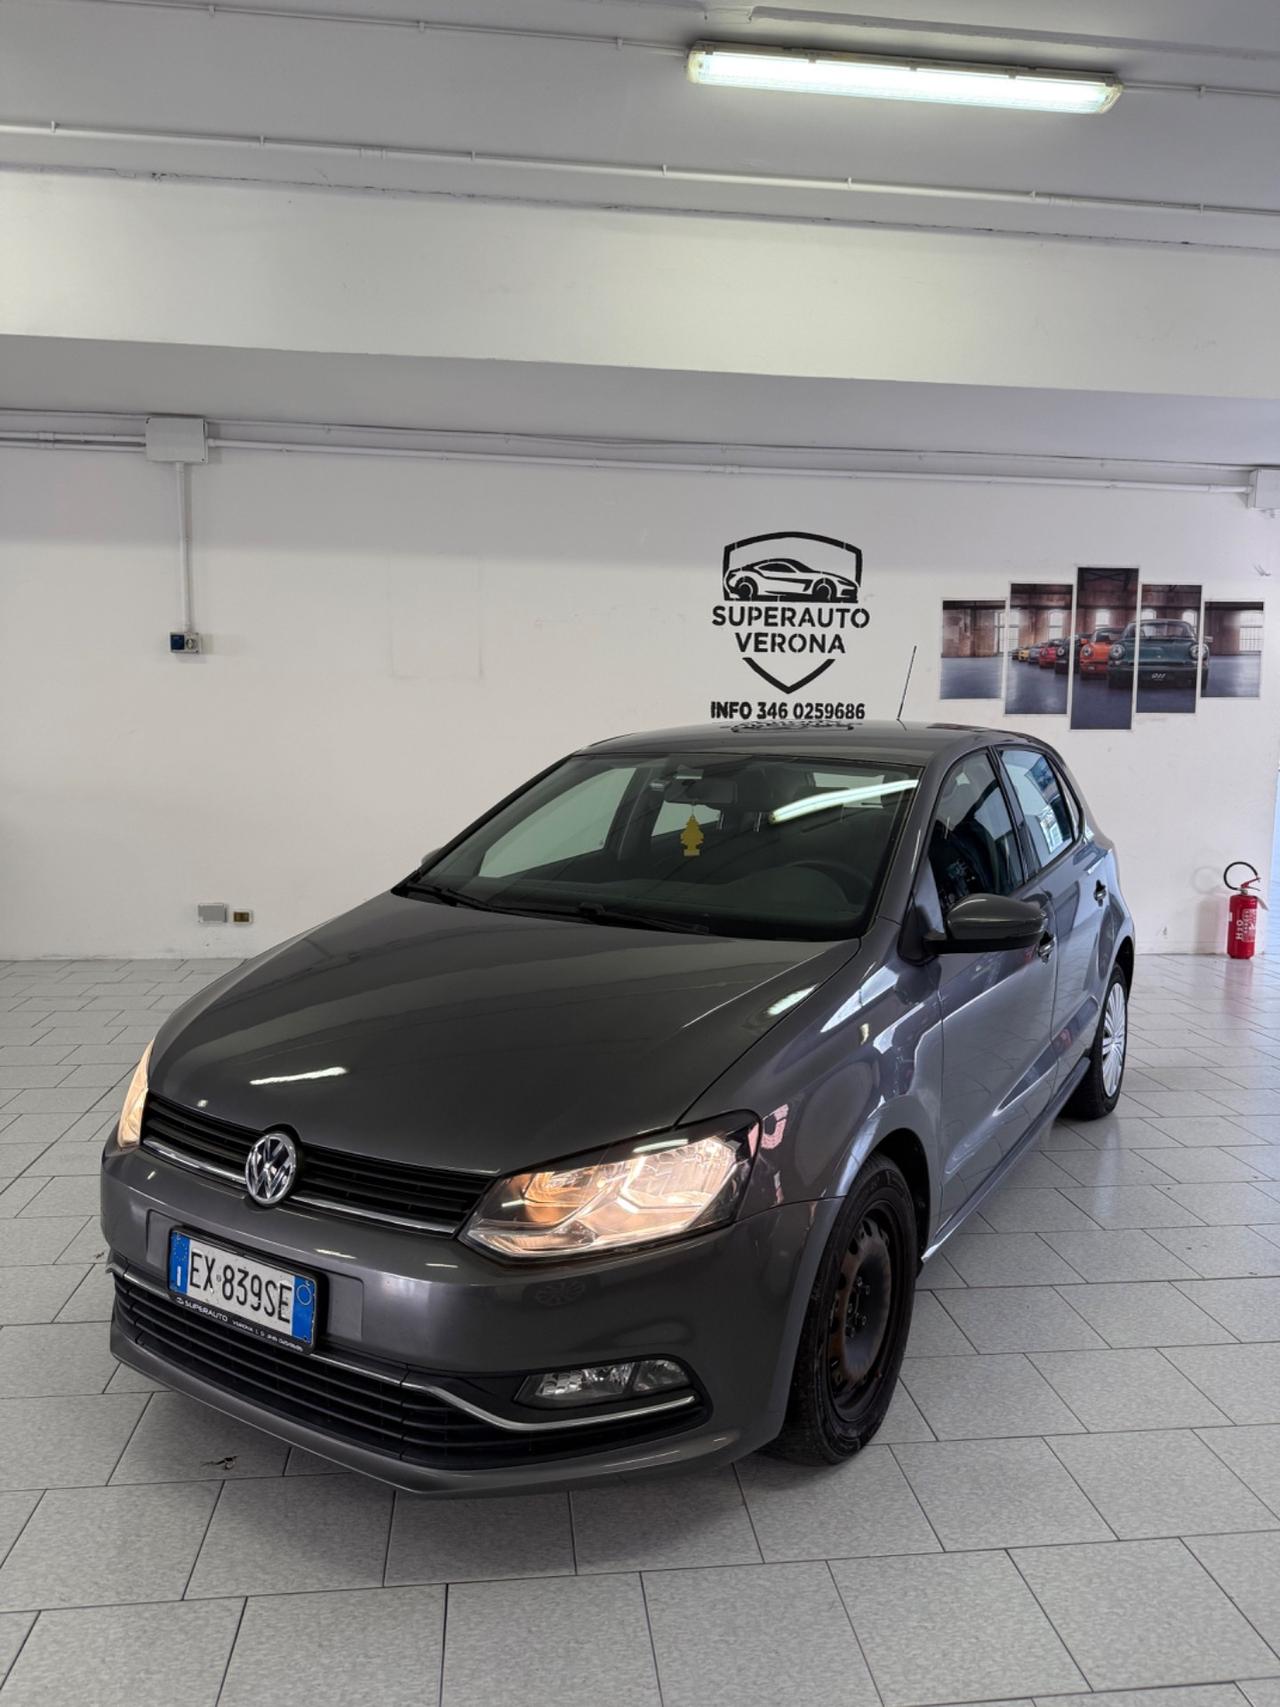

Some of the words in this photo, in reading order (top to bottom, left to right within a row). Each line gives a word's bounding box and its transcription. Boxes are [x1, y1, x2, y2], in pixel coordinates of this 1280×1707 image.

[712, 605, 870, 628] SUPERAUTO
[735, 632, 846, 654] VERONA
[710, 701, 752, 720] INFO
[756, 701, 788, 720] 346
[793, 702, 866, 720] 0259686
[184, 1300, 228, 1322] SUPERAUTO
